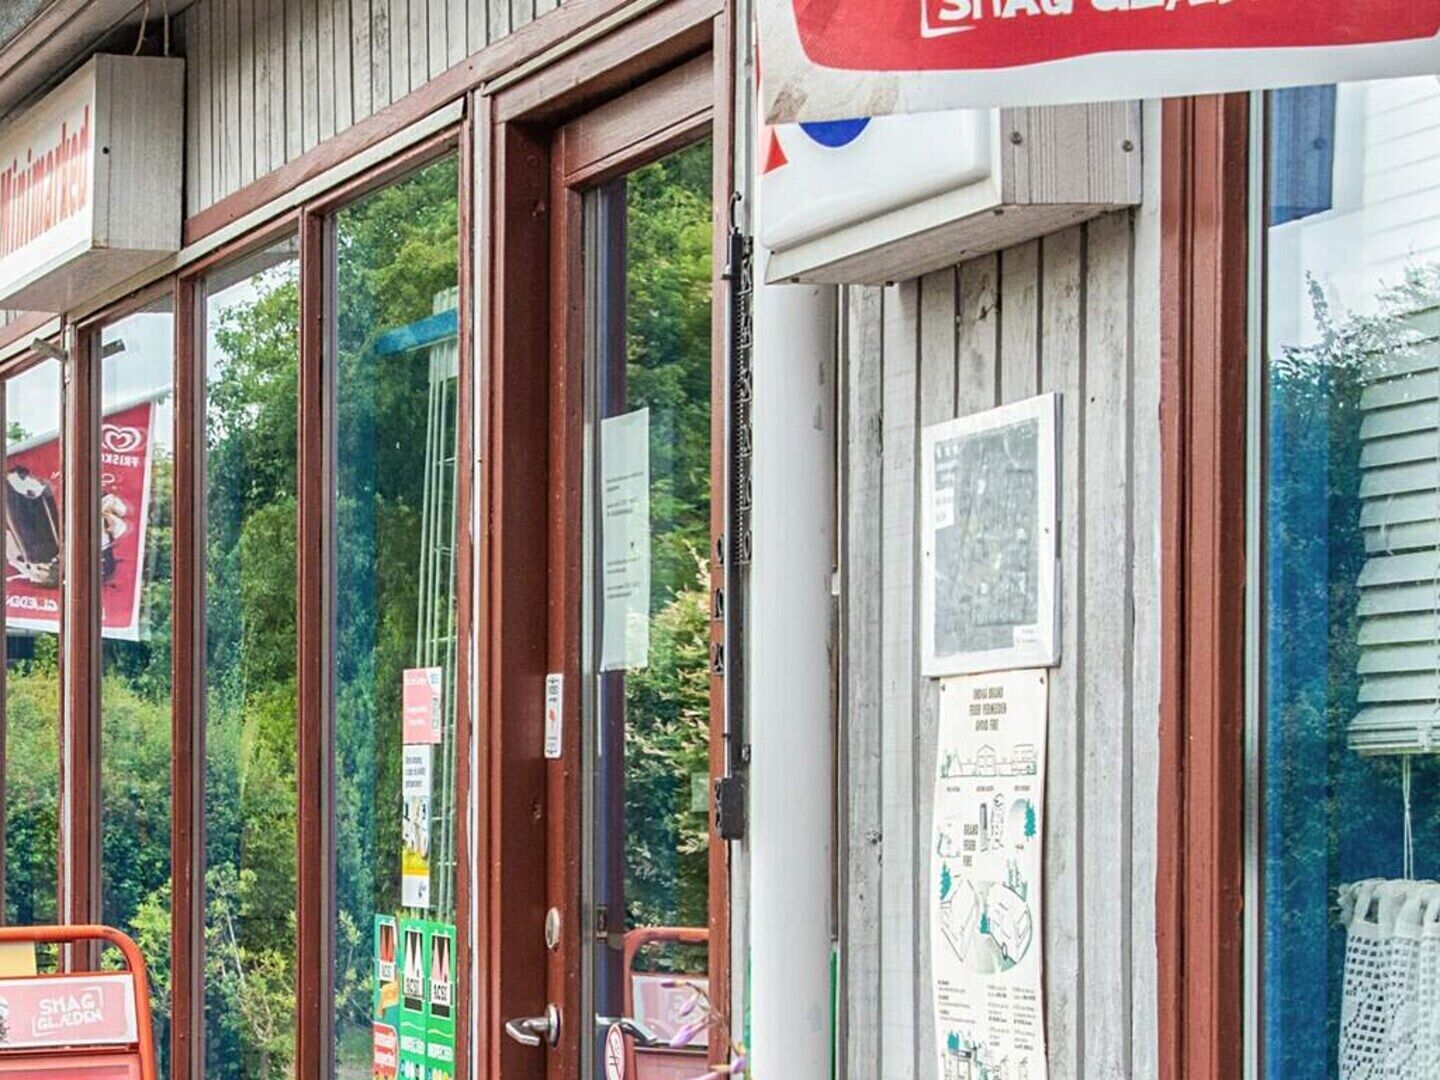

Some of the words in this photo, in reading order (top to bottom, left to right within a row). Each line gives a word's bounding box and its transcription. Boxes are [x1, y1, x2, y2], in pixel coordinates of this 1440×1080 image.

[0, 104, 90, 262] Minimarked
[39, 993, 96, 1015] SMAG
[35, 1009, 103, 1031] GLÆDEN
